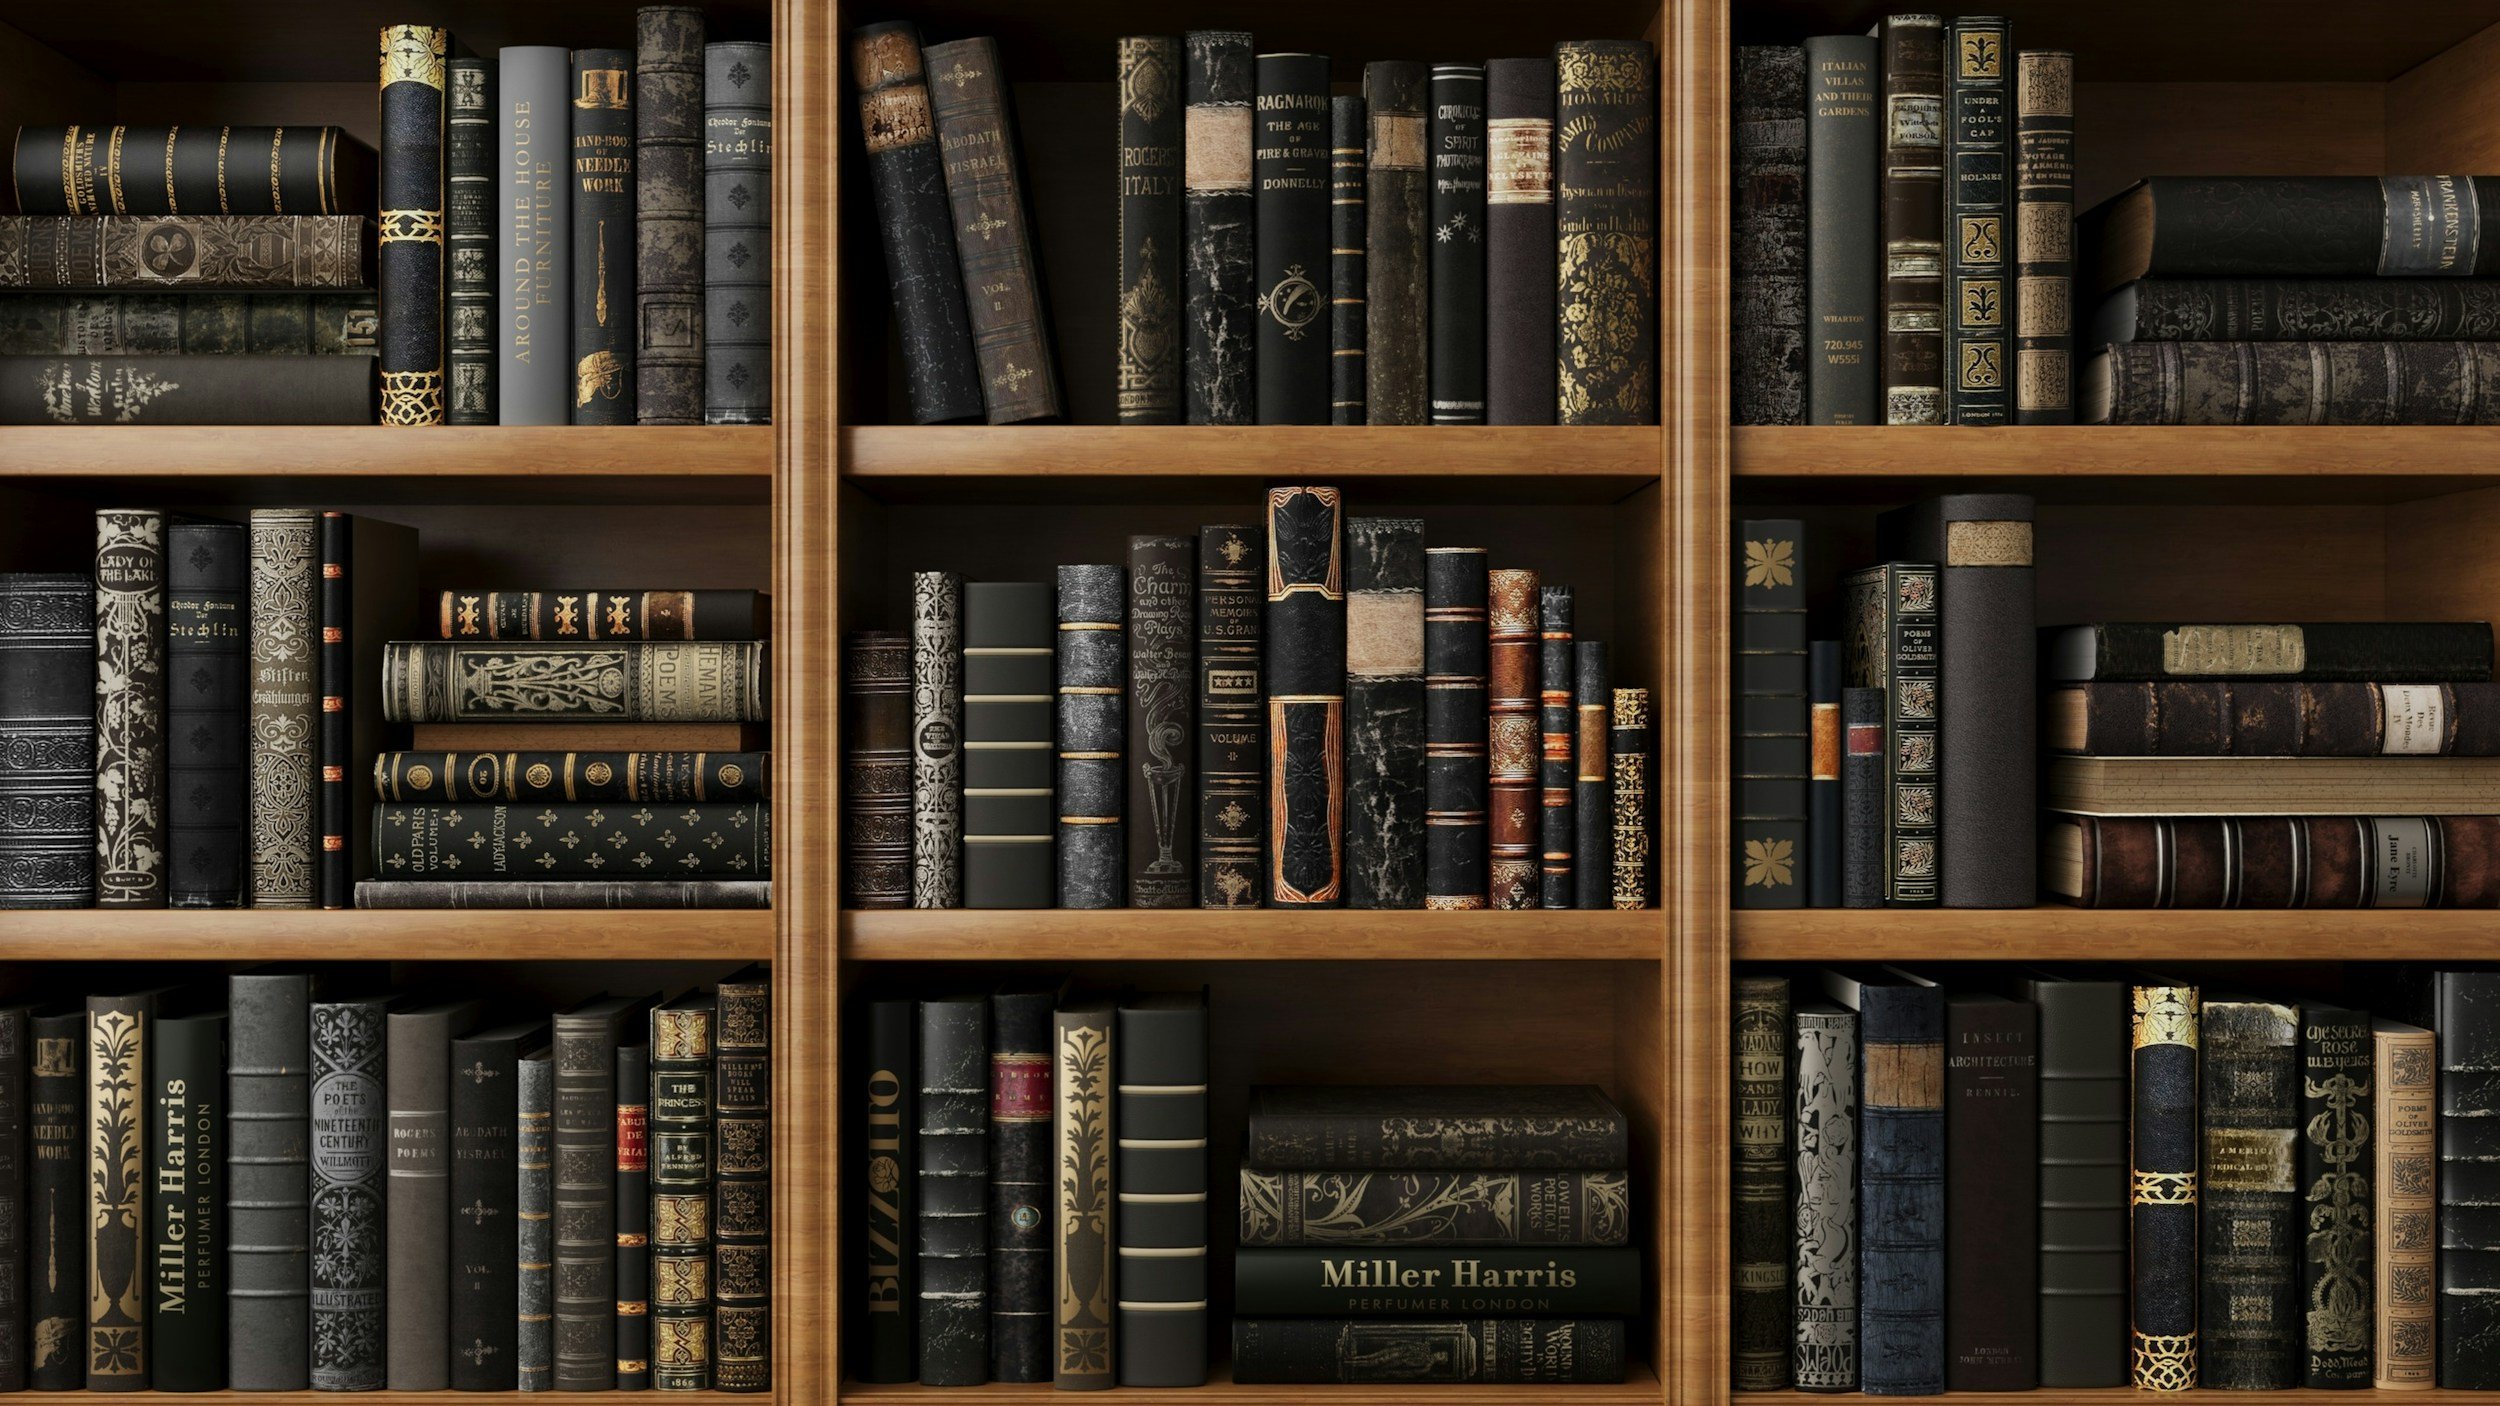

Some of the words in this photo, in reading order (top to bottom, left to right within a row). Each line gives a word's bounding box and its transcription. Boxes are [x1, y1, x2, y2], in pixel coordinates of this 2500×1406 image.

[1822, 62, 1867, 71] ITALIAN
[1825, 77, 1865, 86] VILLAS
[1256, 94, 1329, 114] RAGNAROK
[1815, 92, 1839, 102] AND
[1841, 92, 1873, 101] THEIR
[1964, 97, 2000, 105] UNDER
[1818, 107, 1870, 117] GARDENS
[1266, 121, 1292, 131] THE
[1297, 122, 1321, 131] AGE
[1961, 116, 2002, 124] FOOL'S
[1970, 129, 1995, 138] CAP
[83, 132, 95, 168] NATURE
[514, 101, 531, 185] HOUSE
[1444, 136, 1479, 152] SPIRIT
[1257, 149, 1281, 160] FIRE
[1282, 149, 1290, 158] &
[99, 165, 108, 177] IV
[576, 157, 631, 173] NEEDLE
[950, 156, 1004, 175] YISRAEL
[75, 142, 87, 204] GOLDSMITHS
[1960, 173, 2003, 182] HOLMES
[582, 177, 625, 193] WORK
[1124, 176, 1175, 196] ITALY
[1263, 178, 1326, 190] DONNELLY
[514, 196, 531, 247] THE
[2435, 174, 2459, 270] FRANKENSTEIN
[535, 161, 552, 305] FURNITURE
[71, 216, 95, 285] POEMS
[981, 282, 1012, 297] VOL.
[514, 256, 531, 364] AROUND
[1824, 340, 1864, 350] 720.945
[1828, 355, 1861, 365] W555i
[100, 555, 134, 568] LADY
[1152, 561, 1175, 575] The
[100, 569, 122, 582] THE
[1133, 576, 1192, 596] Charm
[1139, 596, 1158, 607] and
[1131, 608, 1169, 621] Drawing
[1210, 608, 1258, 618] MEMOIRS
[170, 622, 239, 638] Stechlin
[1143, 620, 1184, 640] Plays
[1903, 630, 1931, 638] POEMS
[1132, 649, 1162, 659] Walter
[656, 645, 680, 719] POEMS
[698, 646, 721, 719] HEMANS
[2417, 711, 2425, 729] Des
[1210, 733, 1257, 743] VOLUME
[479, 770, 488, 785] 20
[411, 807, 425, 848] PARIS
[493, 806, 507, 847] JACKSON
[2388, 834, 2399, 864] Jane
[412, 848, 426, 872] OLD
[493, 846, 507, 872] LADY
[2387, 866, 2400, 893] Eyre
[1738, 1035, 1782, 1052] MADAM
[1962, 1032, 2022, 1045] INSECT
[1741, 1061, 1780, 1076] HOW
[1948, 1055, 2036, 1068] ARCHITECTURE
[335, 1082, 358, 1091] THE
[671, 1083, 697, 1094] THE
[1746, 1084, 1775, 1094] AND
[324, 1093, 367, 1105] POETS
[659, 1098, 707, 1108] PRINCESS
[1742, 1100, 1780, 1116] LADY
[2397, 1105, 2428, 1113] POEMS
[315, 1118, 380, 1132] NINETEENTH
[1740, 1125, 1780, 1139] WHY
[159, 1080, 186, 1196] Harris
[320, 1135, 370, 1148] CENTURY
[627, 1131, 643, 1141] DE
[198, 1103, 211, 1185] LONDON
[37, 1144, 72, 1160] WORK
[396, 1148, 438, 1158] POEMS
[456, 1149, 507, 1159] YISRAEL
[665, 1153, 703, 1161] ALFRED
[320, 1156, 371, 1167] WILLMOTT
[1530, 1181, 1541, 1230] WORKS
[1546, 1177, 1557, 1233] POETICAL
[1558, 1173, 1570, 1241] LOWELL'S
[198, 1195, 211, 1290] PERFUMER
[159, 1204, 186, 1316] Miller
[1321, 1258, 1441, 1288] Miller
[1451, 1258, 1577, 1288] Harris
[312, 1290, 382, 1307] ILLUSTRATED
[1348, 1299, 1451, 1311] PERFUMER
[1461, 1299, 1551, 1311] LONDON
[1974, 1347, 2009, 1355] LONDON
